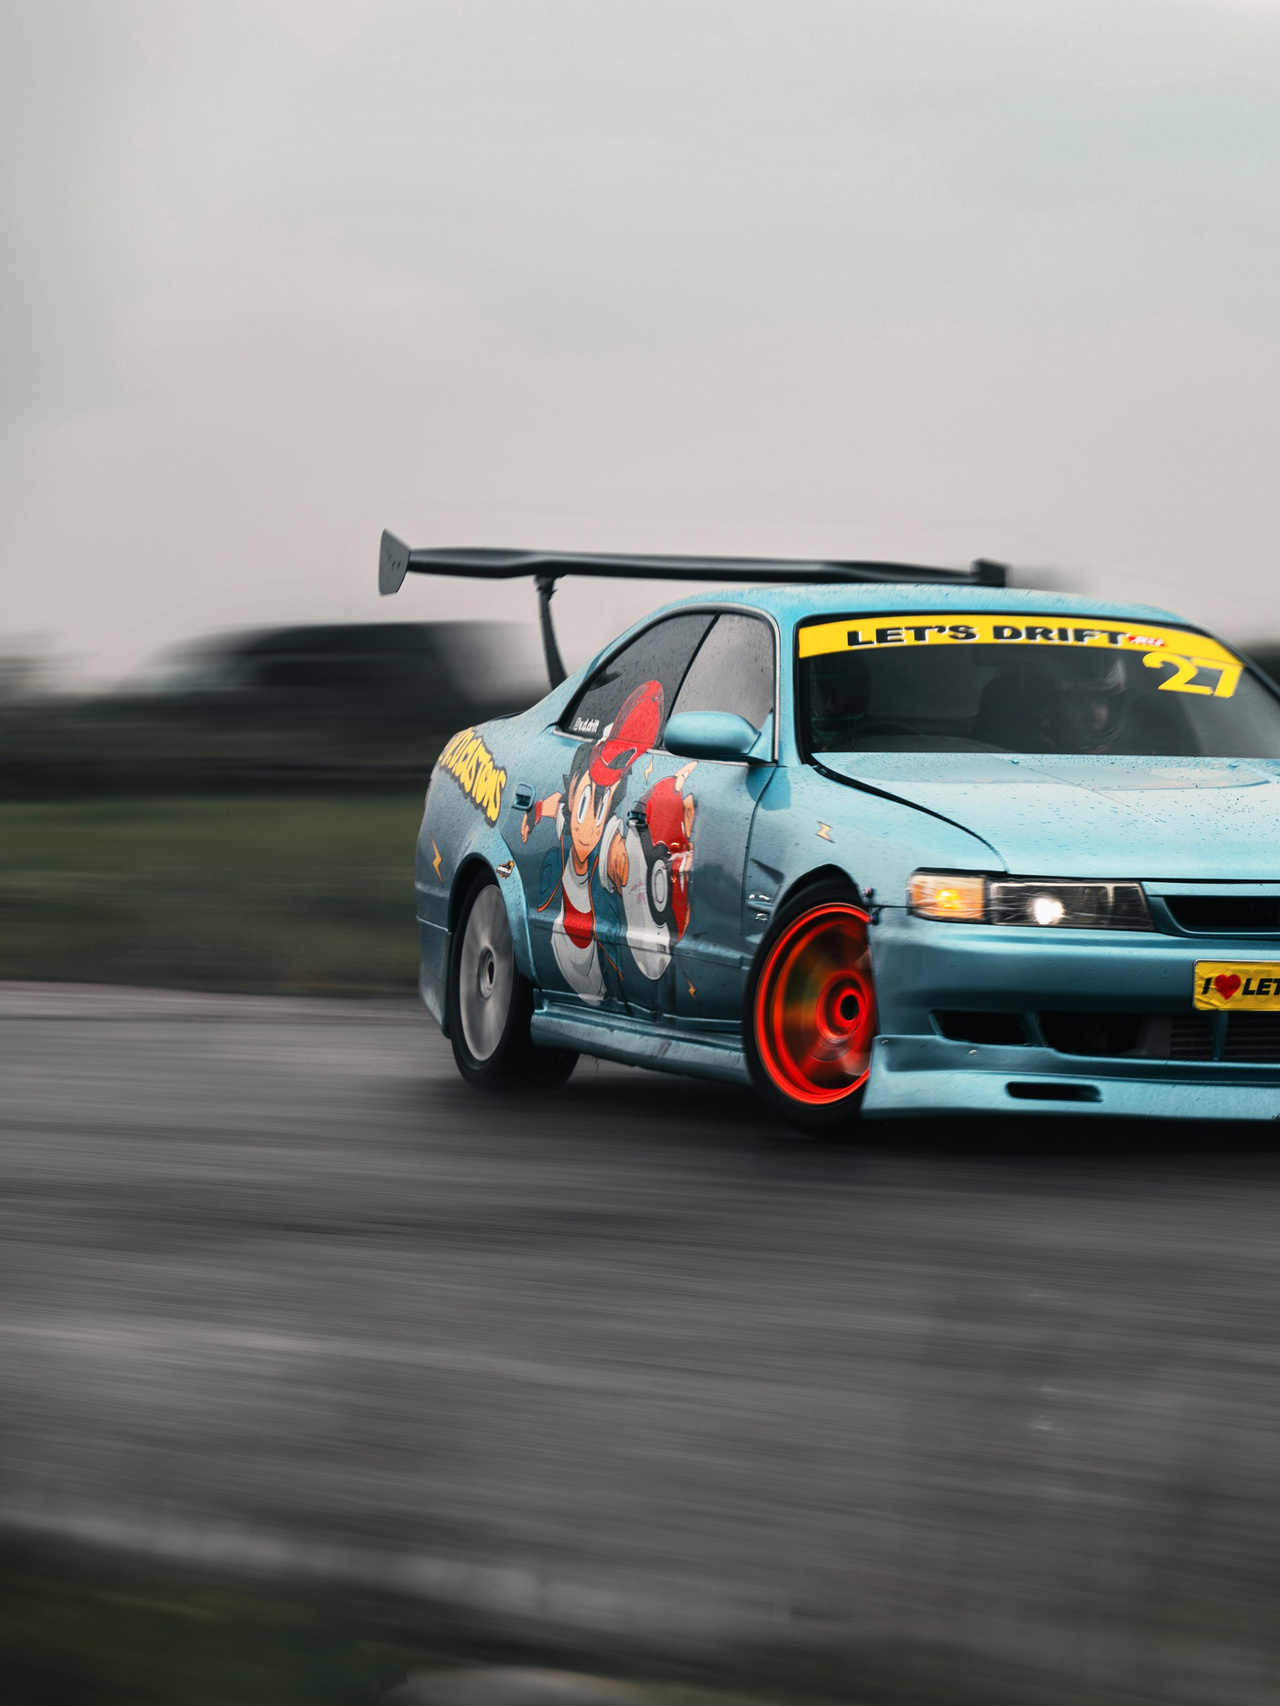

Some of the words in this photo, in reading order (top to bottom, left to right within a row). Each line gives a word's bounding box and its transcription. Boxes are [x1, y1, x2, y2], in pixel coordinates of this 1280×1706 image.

[847, 624, 979, 647] LET'S
[1142, 651, 1243, 698] 27
[1202, 977, 1212, 995] I
